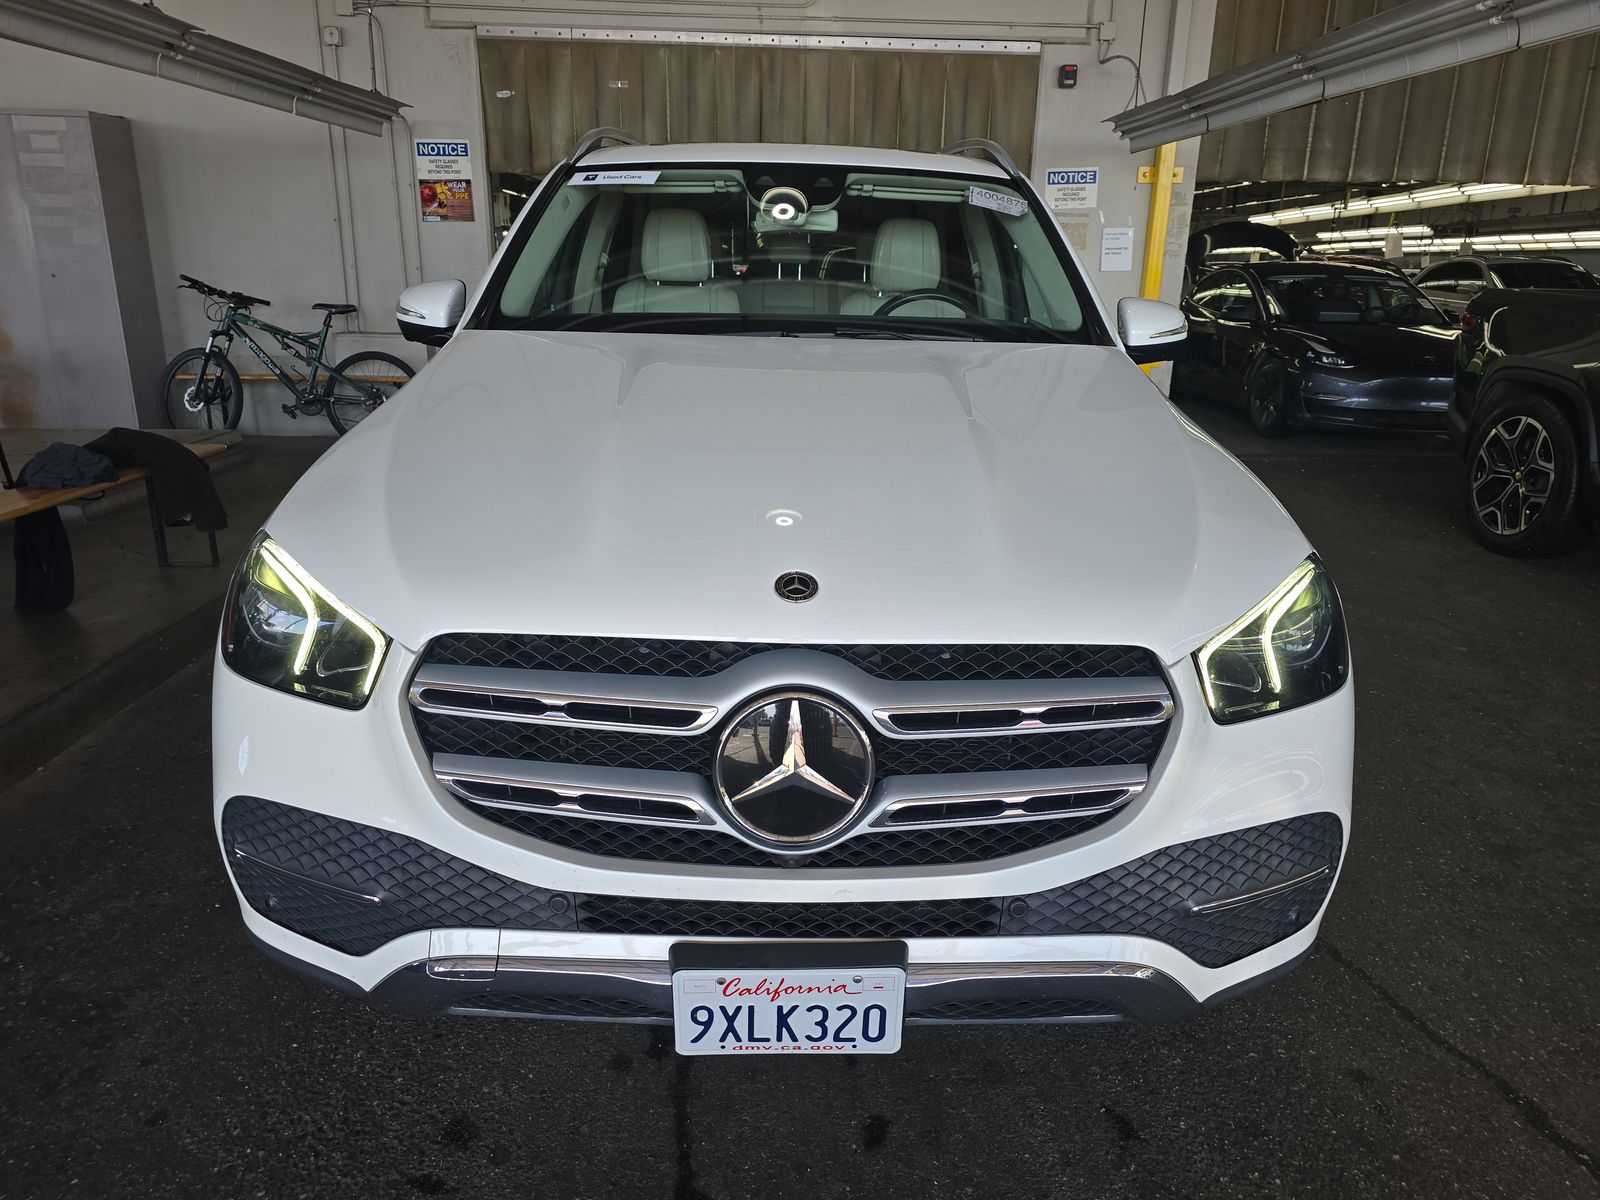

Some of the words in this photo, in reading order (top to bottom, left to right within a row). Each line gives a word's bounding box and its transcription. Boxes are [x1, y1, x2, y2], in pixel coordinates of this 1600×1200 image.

[419, 143, 467, 156] NOTICE
[1049, 171, 1095, 184] NOTICE
[456, 192, 470, 200] PPE
[722, 977, 863, 1002] California
[690, 1004, 887, 1043] 9XLK320
